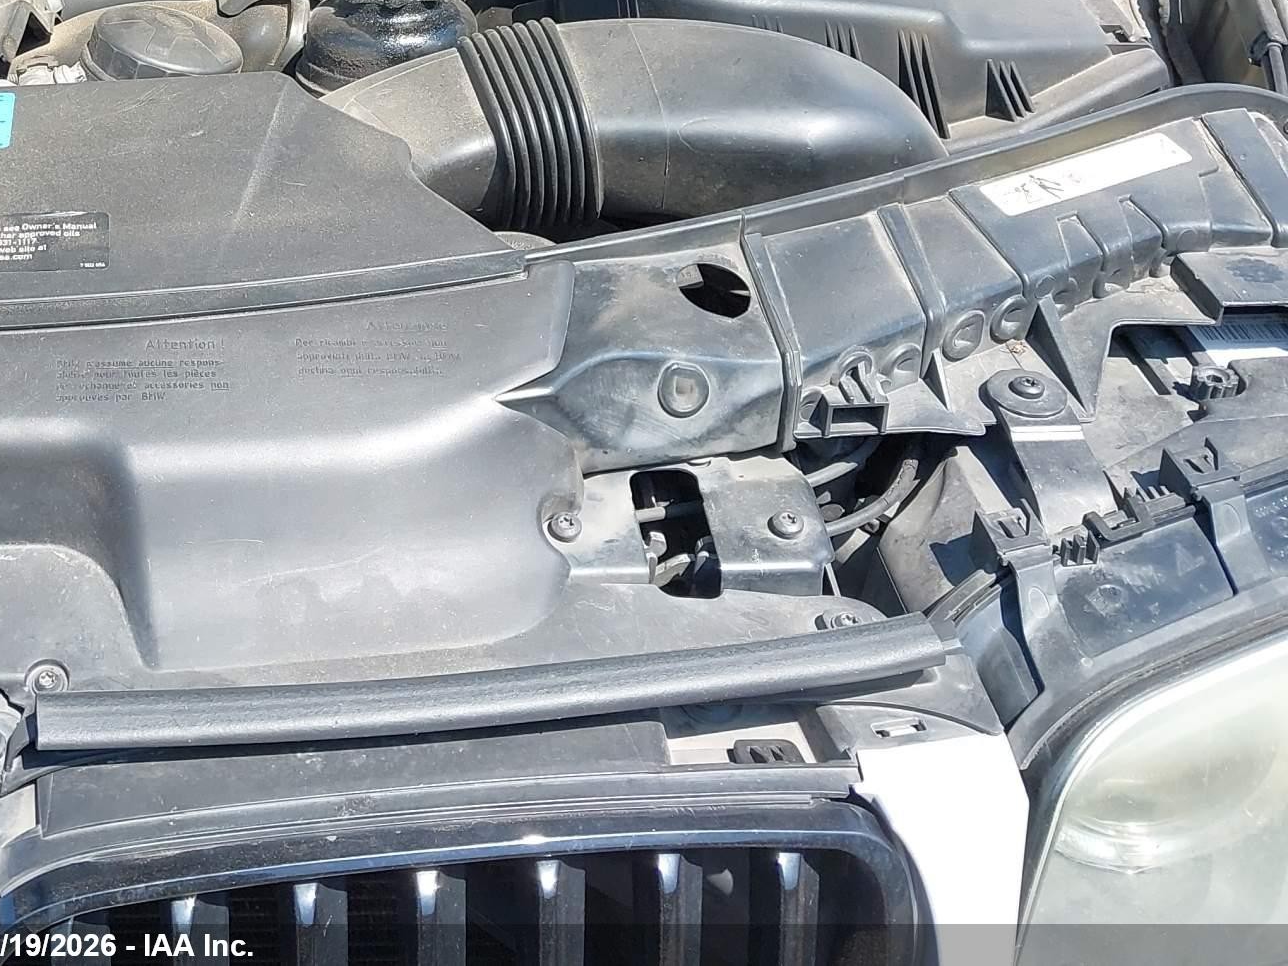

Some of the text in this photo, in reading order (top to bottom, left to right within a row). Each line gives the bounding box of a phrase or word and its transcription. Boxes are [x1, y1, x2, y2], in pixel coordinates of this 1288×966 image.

[22, 223, 59, 231] Owner's
[63, 222, 97, 230] Manual
[18, 230, 61, 240] approved
[63, 229, 80, 237] oils
[145, 338, 215, 351] Attention
[138, 359, 174, 369] aucune
[163, 369, 179, 379] les
[184, 368, 217, 380] pièces
[115, 392, 132, 403] par
